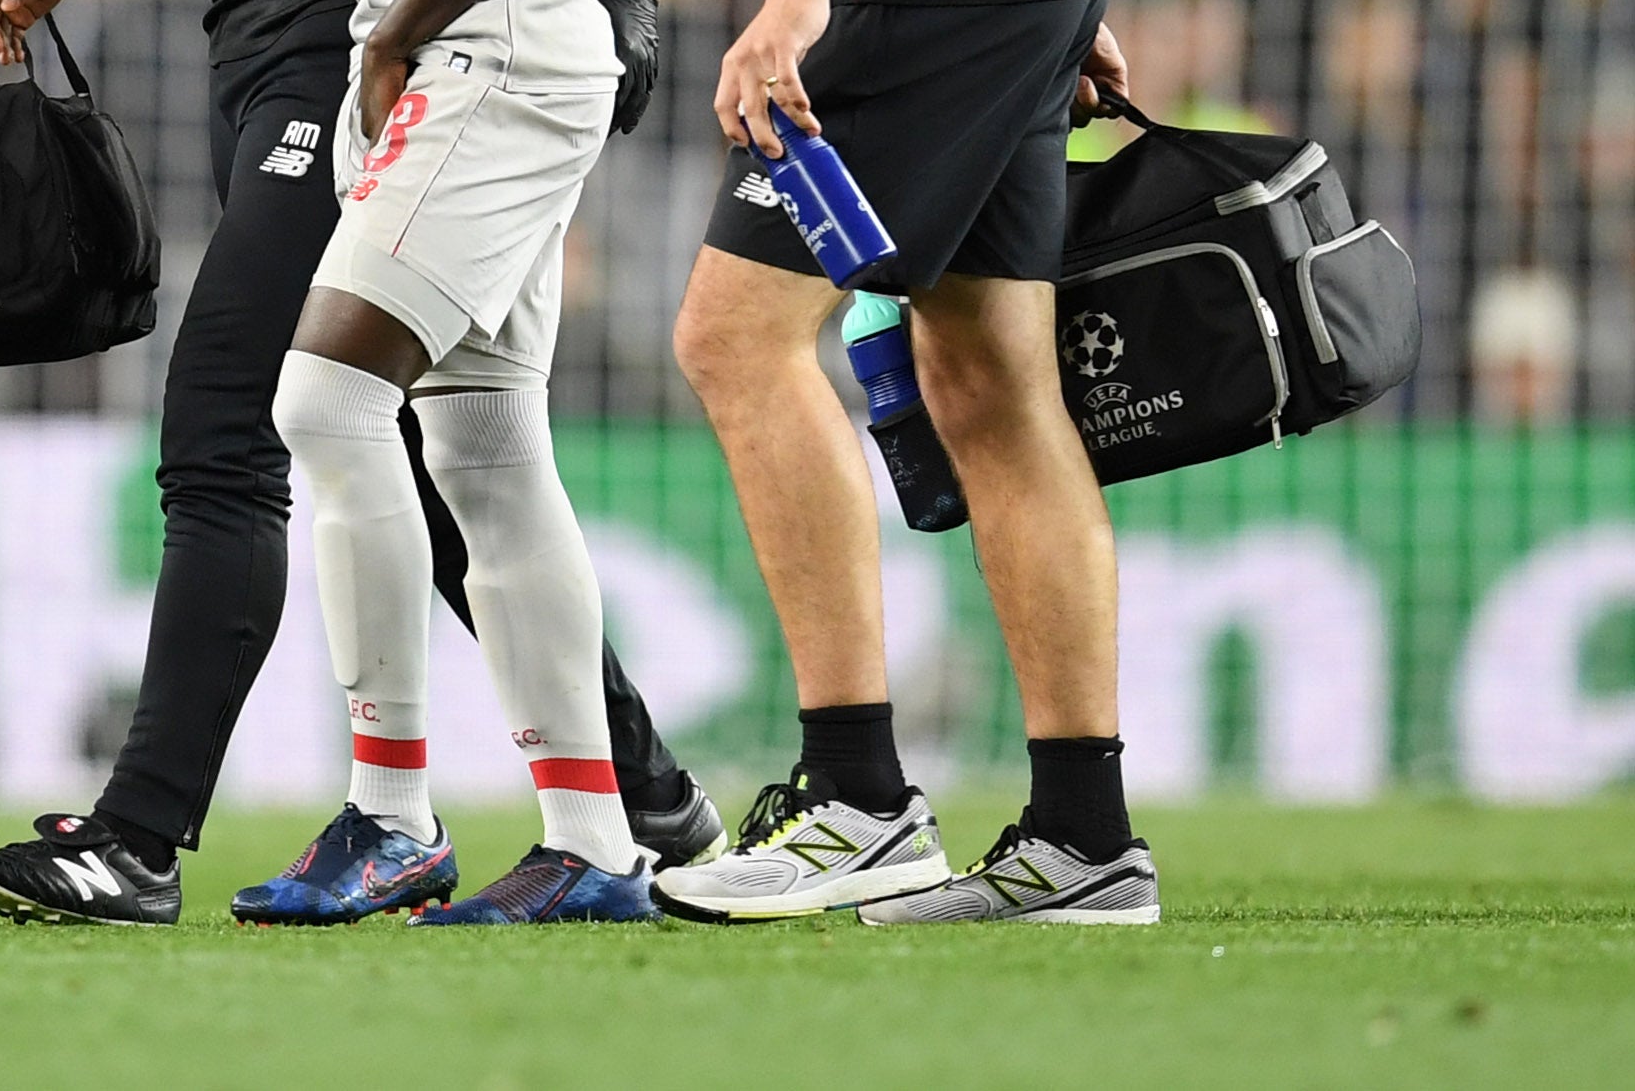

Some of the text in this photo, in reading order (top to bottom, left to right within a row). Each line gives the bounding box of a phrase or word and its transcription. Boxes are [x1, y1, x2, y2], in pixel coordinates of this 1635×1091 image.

[281, 120, 322, 150] AM
[1081, 390, 1184, 435] AMPIONS
[1085, 386, 1129, 409] UEFA
[1088, 421, 1157, 451] LEAGUE
[350, 698, 382, 724] F.C.
